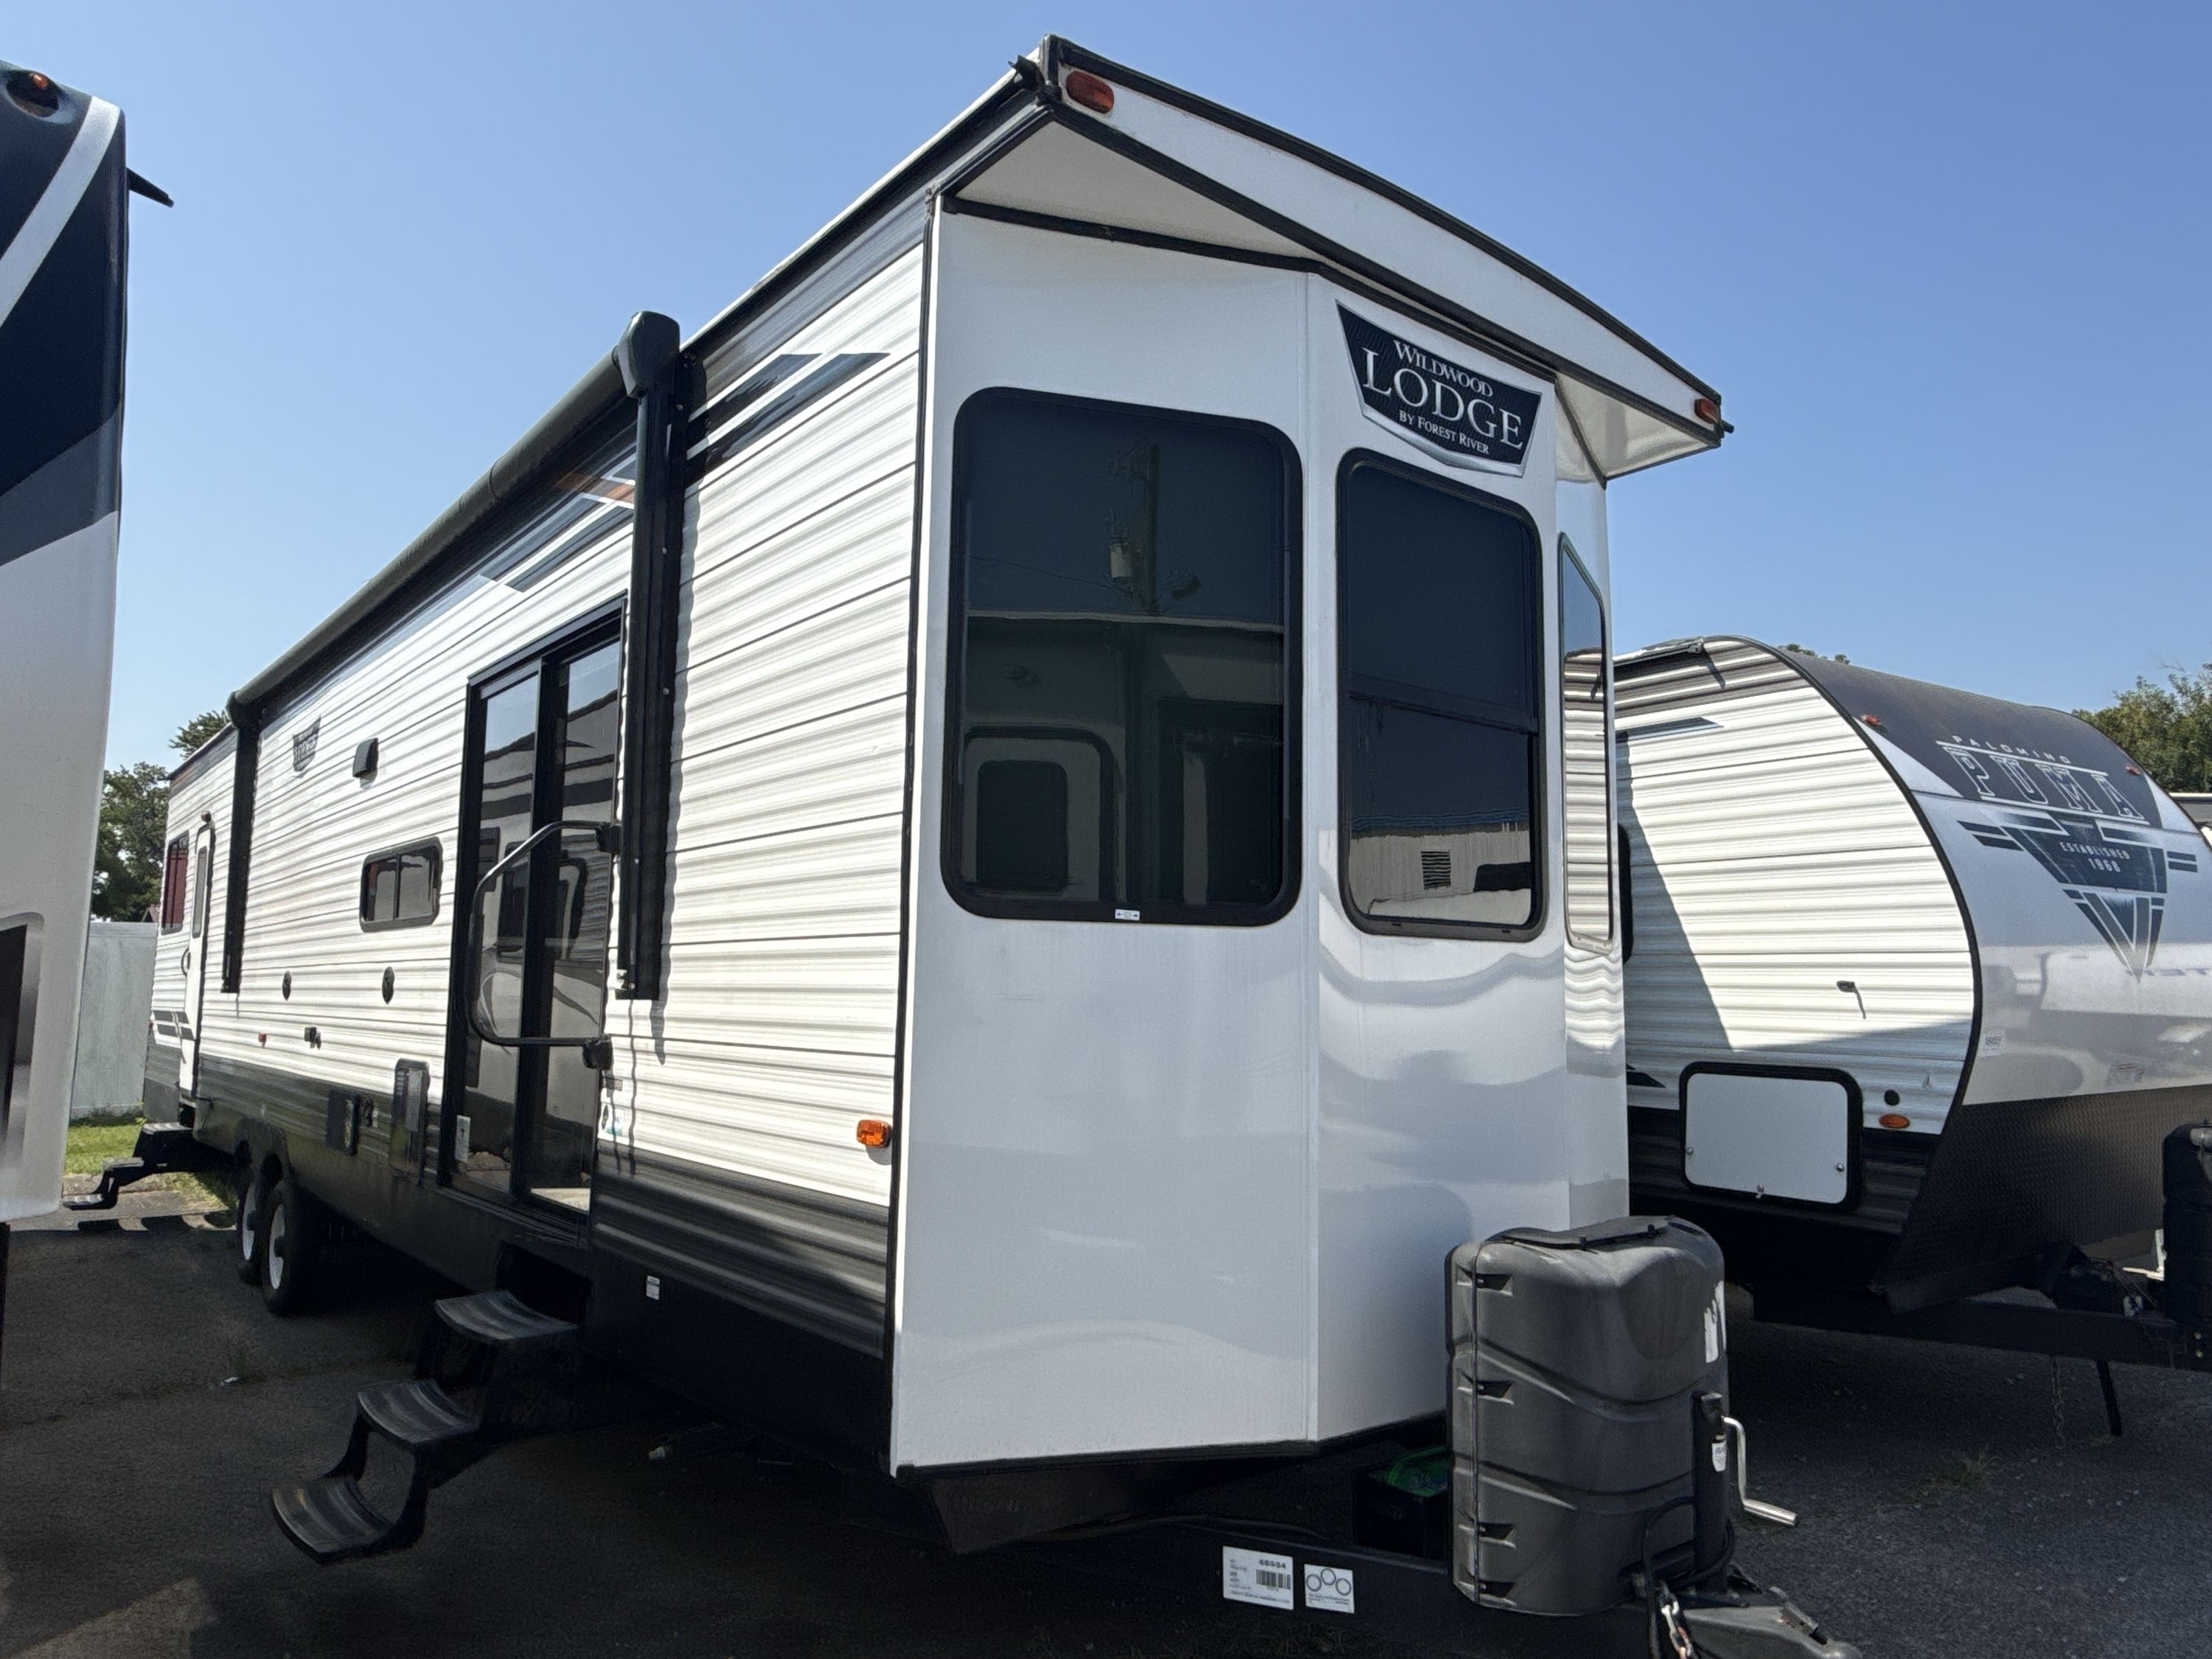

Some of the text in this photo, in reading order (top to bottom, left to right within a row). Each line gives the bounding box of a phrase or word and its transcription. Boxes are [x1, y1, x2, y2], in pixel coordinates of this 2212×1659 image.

[1393, 339, 1493, 397] WILDWOOD
[1363, 347, 1523, 451] LODGE
[1399, 409, 1490, 455] BY FOREST RIVER
[1952, 735, 2071, 764] PALOMINO
[1941, 745, 2146, 821] PUMA
[2059, 841, 2131, 860] ESTABLISHED
[2087, 858, 2121, 872] 1968
